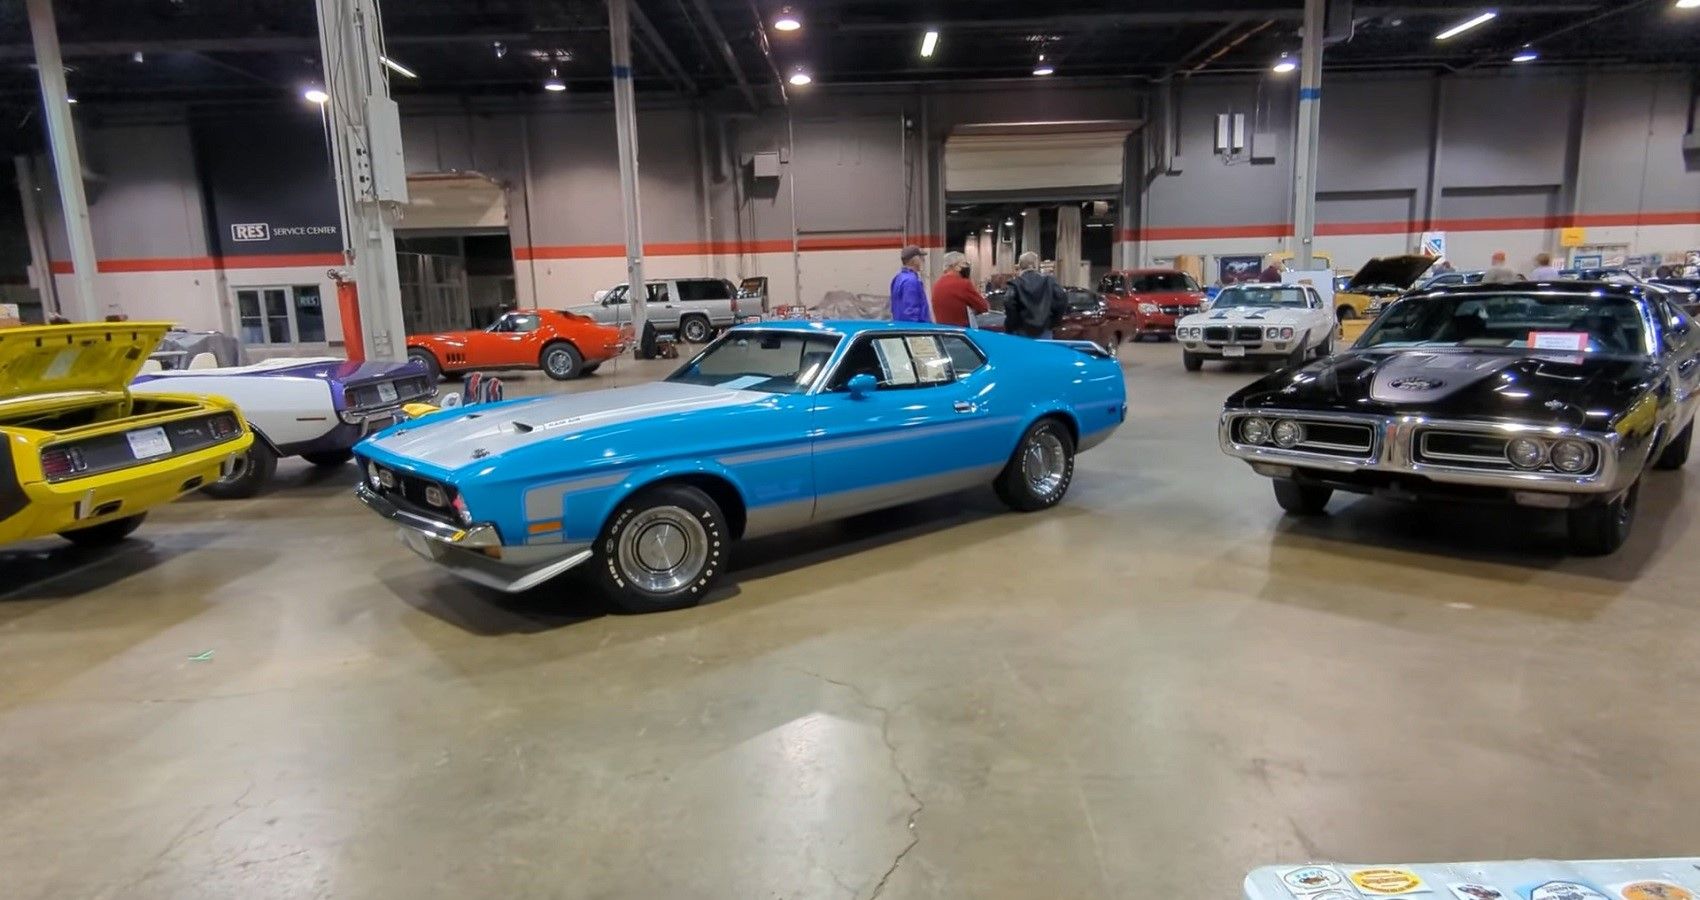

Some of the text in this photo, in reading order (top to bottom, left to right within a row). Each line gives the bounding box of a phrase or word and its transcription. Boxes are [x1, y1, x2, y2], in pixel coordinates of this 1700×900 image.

[236, 225, 265, 239] RES
[273, 226, 337, 236] SERVICE CENTER
